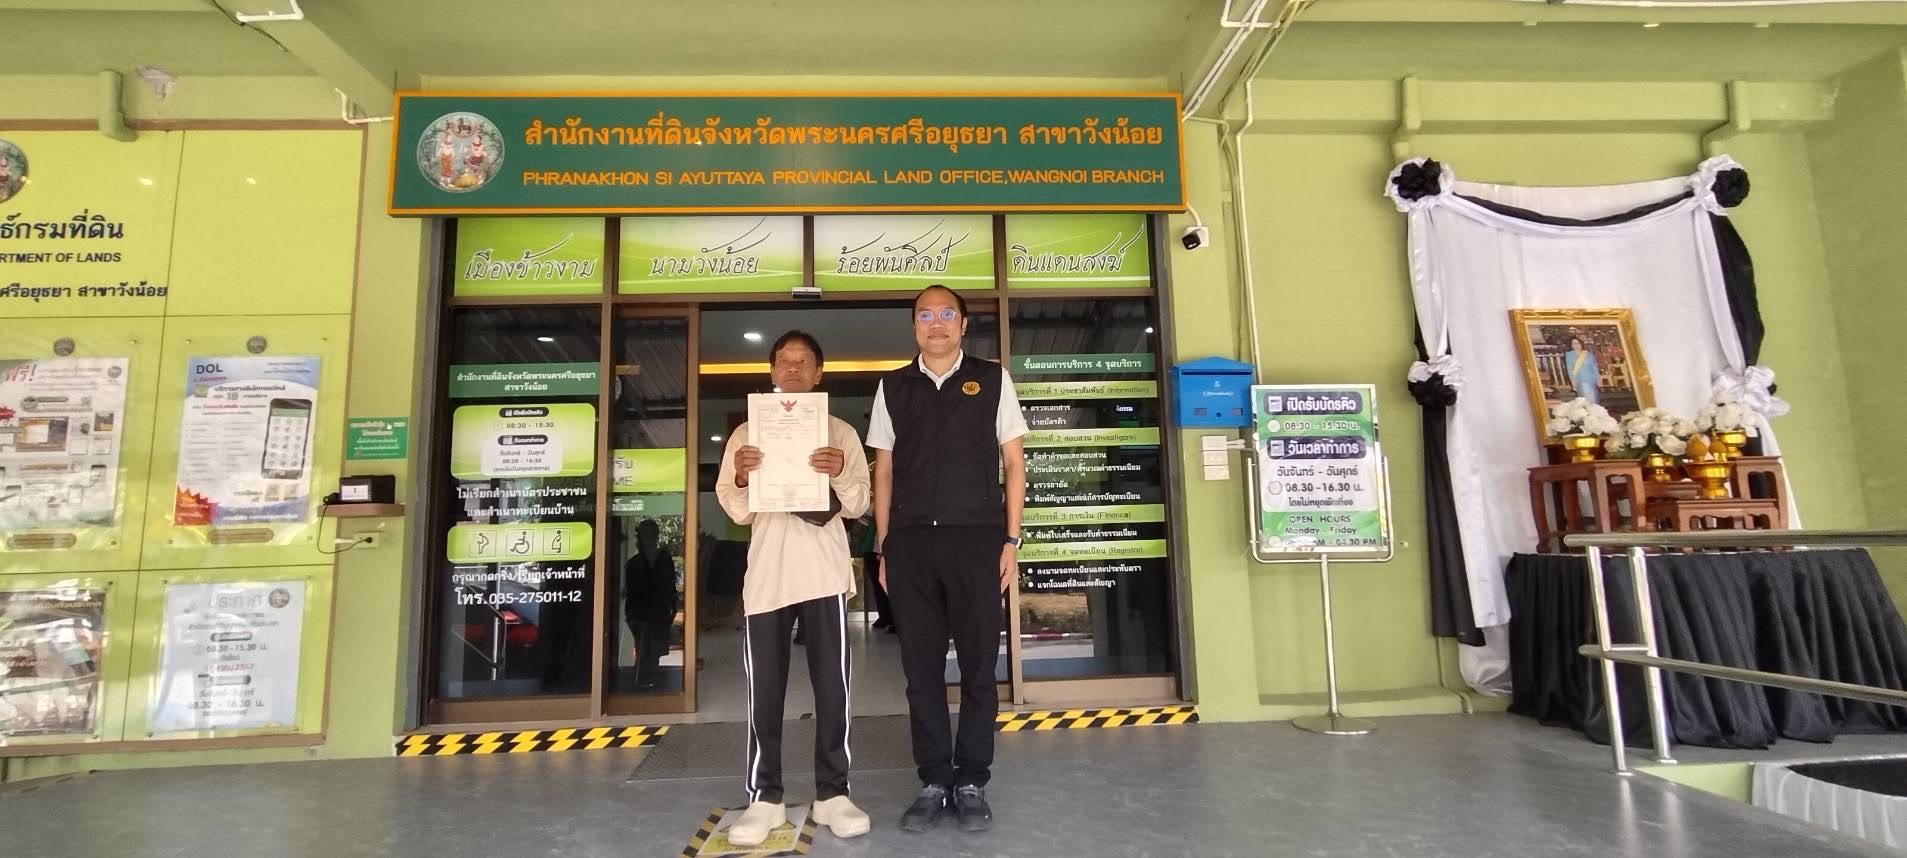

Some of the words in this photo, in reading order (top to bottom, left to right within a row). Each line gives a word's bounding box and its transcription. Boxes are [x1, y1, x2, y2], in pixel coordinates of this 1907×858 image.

[525, 111, 1007, 153] สำนักงานที่ดินจังหวัดพระนครศรีอยุธยา
[1020, 117, 1163, 145] สาขาวังน้อย
[523, 171, 648, 185] PHRANAKHON
[655, 171, 672, 185] SI
[679, 171, 765, 185] AYUTTAYA
[772, 170, 877, 185] PROVINCIAL
[883, 170, 933, 184] LAND
[1091, 170, 1164, 184] BRANCH
[0, 209, 124, 240] ธ์กรมที่ดิน
[1010, 222, 1145, 273] ดินแดนสงฆ์
[0, 252, 52, 263] RTMENT
[55, 252, 73, 262] OF
[77, 252, 122, 263] LANDS
[0, 282, 71, 302] ศรีอยุธยา
[78, 280, 168, 298] สาขาวังน้อย
[196, 363, 224, 375] DOL
[1024, 357, 1092, 369] ขั้นตอนการบริการ
[1105, 359, 1142, 370] จุดบริการ
[457, 368, 596, 383] สำนักงานที่ดินจังหวัดพระนครศรีอยุธยา
[504, 382, 548, 391] สาขาวังน้อย
[1287, 396, 1357, 412] เปิดรับบัตรคิว
[506, 422, 526, 430] 08:30
[535, 421, 555, 429] 15:30
[1284, 421, 1311, 431] 08:30
[1287, 439, 1359, 455] วันเวลาทำการ
[1277, 465, 1314, 477] วันจันทร์
[1326, 464, 1359, 479] วันศุกร์
[456, 485, 587, 500] ไม่เรียกสำเนาบัตรประชาชน
[467, 503, 574, 517] และสำเนาทะเบียนบ้าน
[1289, 515, 1313, 523] OPEN
[1319, 515, 1352, 523] HOURS
[1285, 527, 1320, 537] Monday
[1330, 526, 1357, 535] Friday
